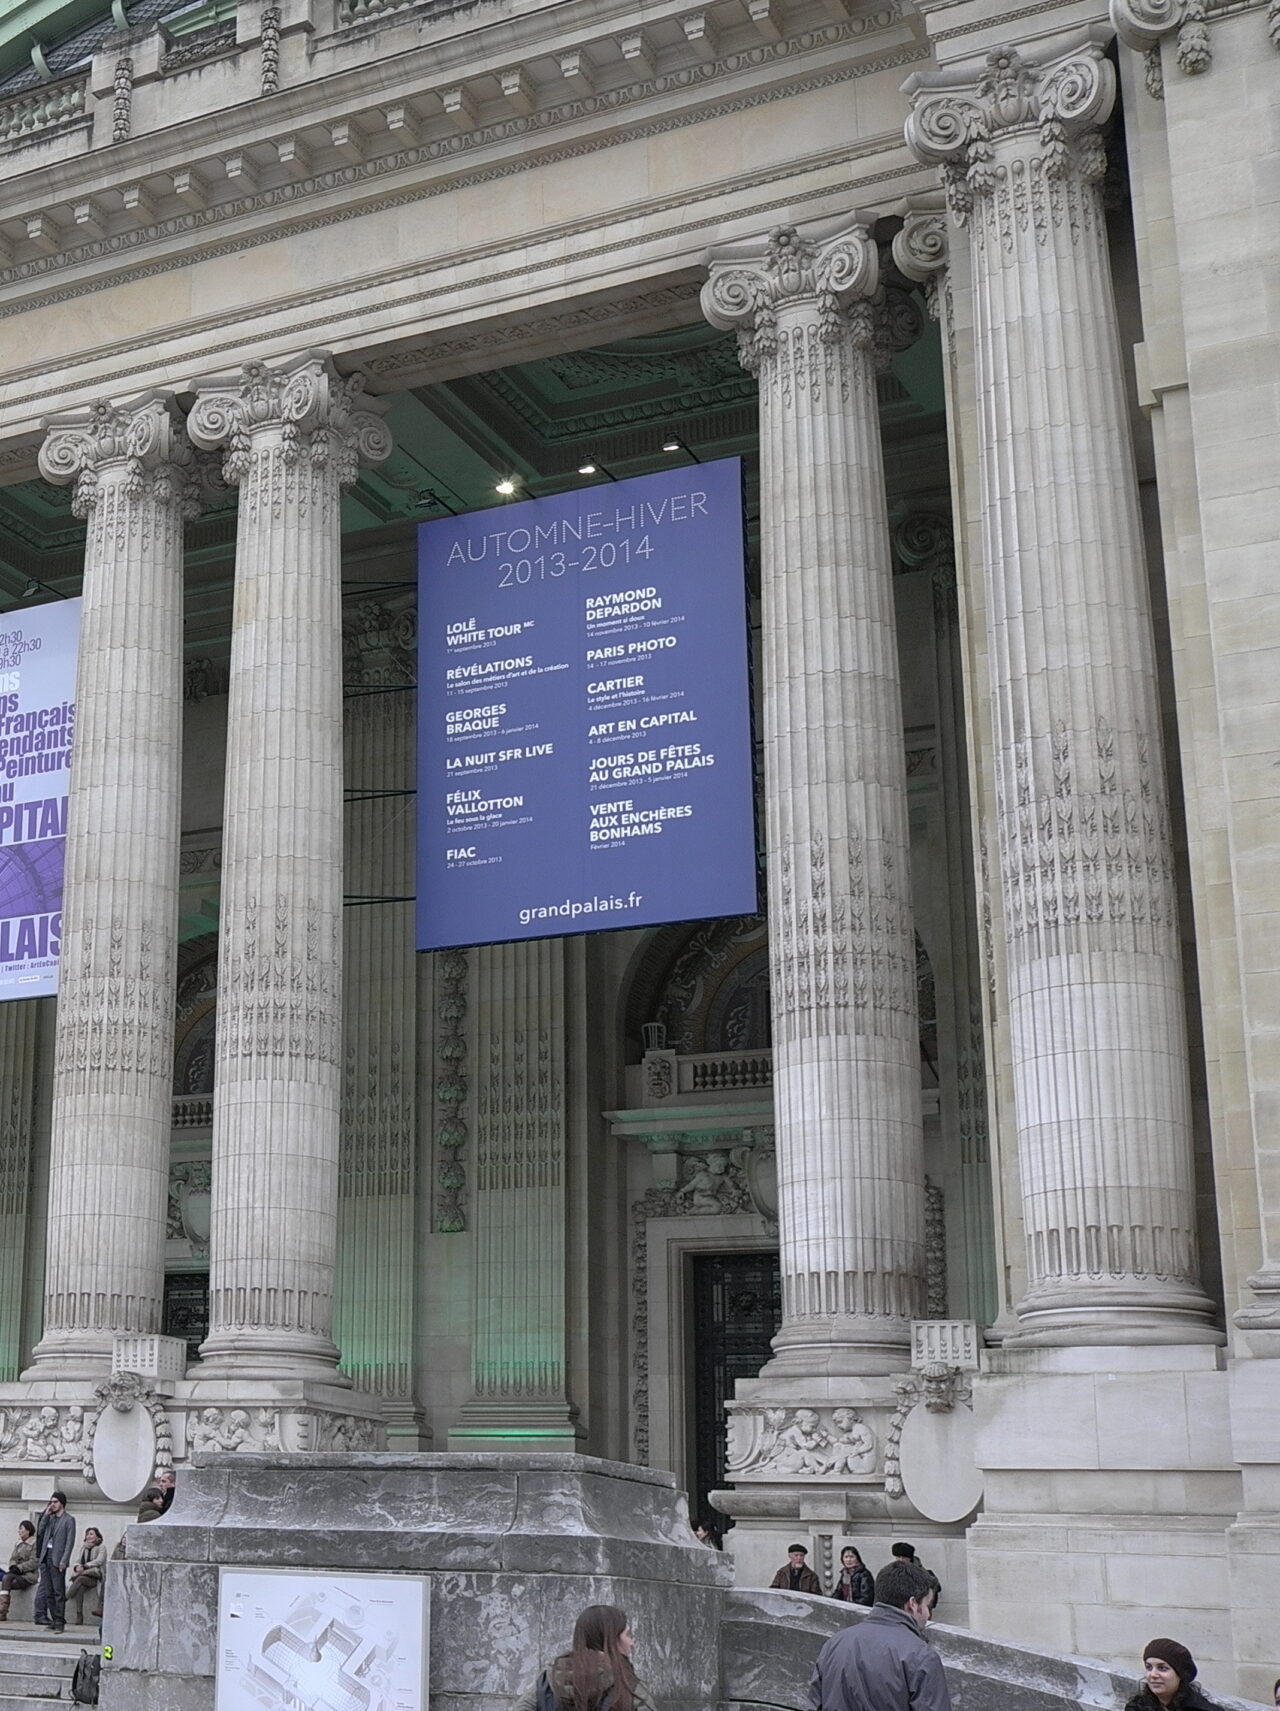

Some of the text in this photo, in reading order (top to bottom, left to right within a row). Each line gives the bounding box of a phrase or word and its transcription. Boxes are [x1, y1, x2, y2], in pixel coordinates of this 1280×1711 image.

[446, 491, 708, 566] AUTOMNE-HIVER
[497, 534, 654, 588] 2013-2014
[586, 587, 656, 608] RAYMOND
[586, 598, 662, 621] DEPARDON
[446, 618, 476, 634] LOLË
[595, 628, 622, 636] novembre
[597, 619, 621, 628] moment
[447, 630, 485, 646] WHITE
[488, 624, 521, 638] TOUR
[3, 645, 9, 656] à
[12, 638, 41, 654] 22h30
[454, 644, 481, 653] septembre
[587, 636, 676, 661] PARIS PHOTO
[447, 656, 533, 680] RÉVÉLATIONS
[608, 657, 636, 666] novembre
[472, 678, 482, 686] des
[483, 674, 505, 683] métiers
[587, 676, 644, 694] CARTIER
[465, 685, 493, 694] septembre
[596, 694, 610, 703] style
[446, 704, 506, 722] GEORGES
[593, 702, 621, 710] décembre
[447, 717, 499, 735] BRAQUE
[588, 710, 697, 736] ART EN CAPITAL
[454, 733, 482, 742] septembre
[602, 734, 630, 743] décembre
[446, 743, 553, 769] LA NUIT SFR LIVE
[589, 744, 700, 770] JOURS DE FÊTES
[455, 768, 483, 776] septembre
[589, 754, 714, 783] AU GRAND PALAIS
[599, 780, 627, 790] décembre
[447, 790, 481, 804] FÉLIX
[447, 796, 523, 815] VALLOTTON
[487, 813, 502, 821] glace
[590, 800, 633, 816] VENTE
[590, 805, 692, 829] AUX ENCHÈRES
[590, 822, 662, 842] BONHAMS
[447, 847, 476, 860] FIAC
[520, 891, 642, 924] grandpalais.fr
